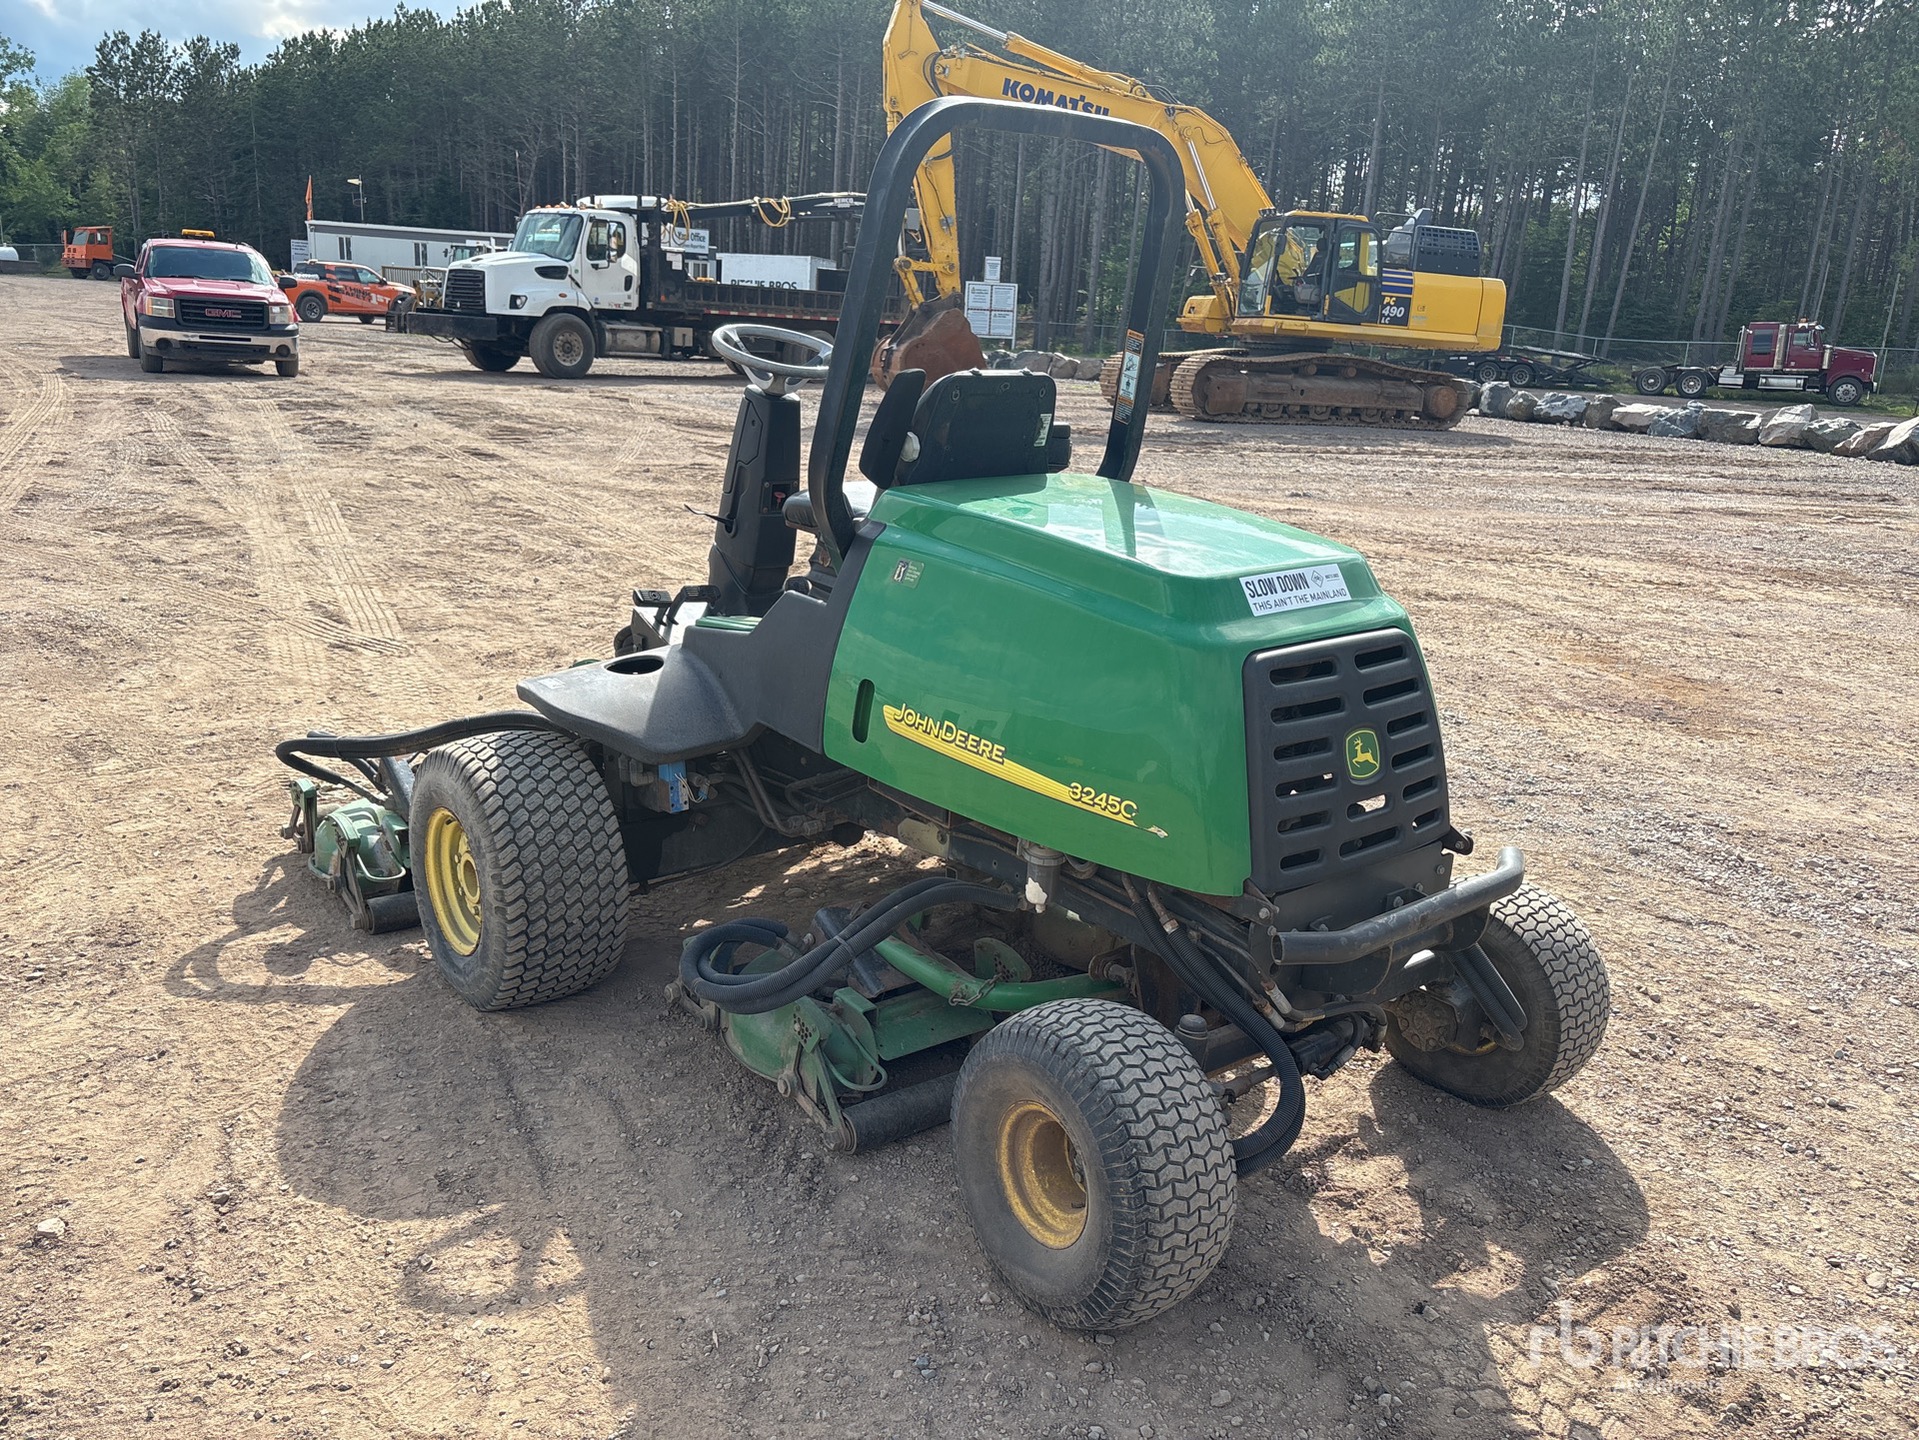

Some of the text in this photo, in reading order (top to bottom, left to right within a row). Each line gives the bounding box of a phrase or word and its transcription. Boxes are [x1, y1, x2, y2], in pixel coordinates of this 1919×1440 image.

[691, 232, 706, 243] Office
[1383, 296, 1397, 305] PC
[205, 308, 242, 318] GMC
[1382, 306, 1405, 318] 490
[1380, 316, 1391, 324] LC
[1245, 572, 1310, 599] SLOW DOWN
[1252, 587, 1348, 612] THIS AIN'T THE MAINLAND
[893, 703, 1006, 765] JOHN DEERE
[1068, 782, 1138, 819] 3245C
